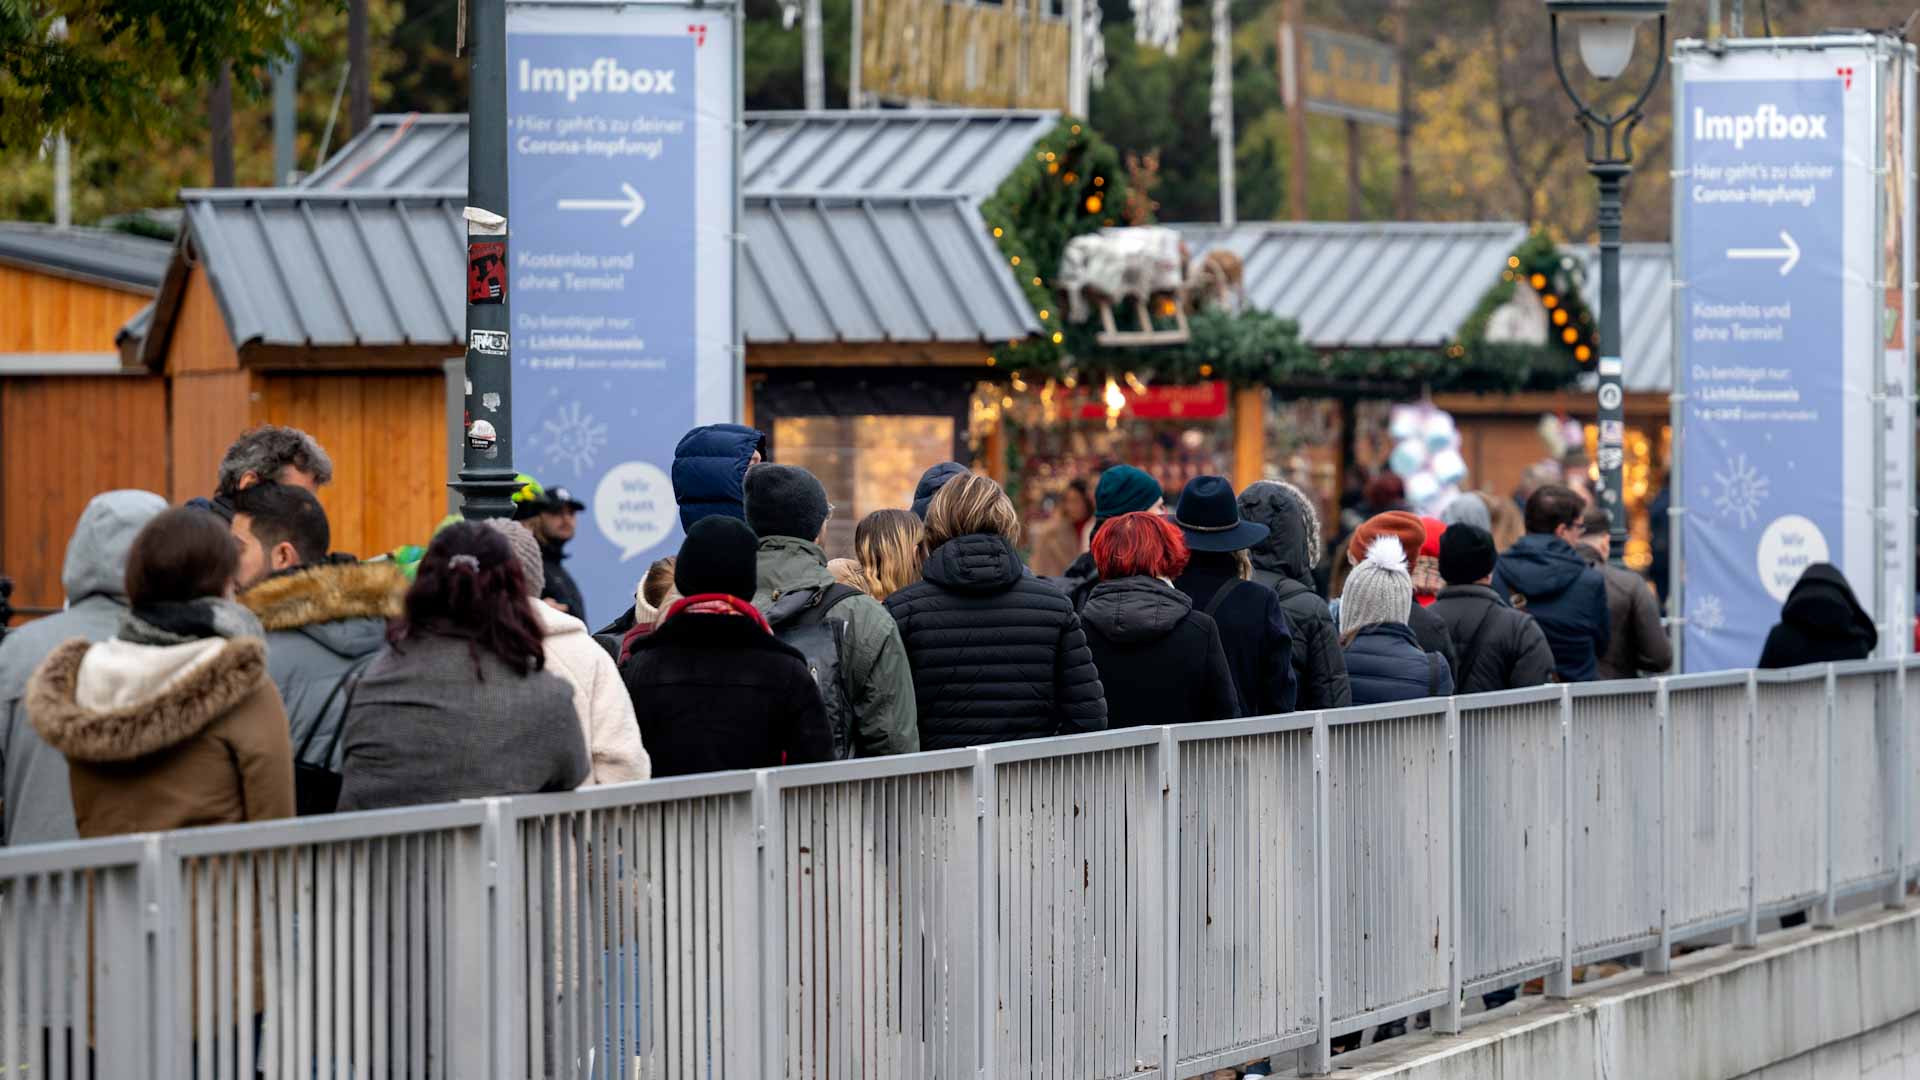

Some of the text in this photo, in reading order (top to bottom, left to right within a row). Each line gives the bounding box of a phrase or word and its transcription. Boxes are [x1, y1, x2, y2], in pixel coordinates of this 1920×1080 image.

[517, 58, 676, 102] Impfbox
[517, 116, 684, 136] Hier geht's zu deiner
[1693, 103, 1828, 150] Impfbox
[517, 137, 663, 159] Corona-Impfung!
[1693, 164, 1722, 181] Hier
[1770, 167, 1788, 180] zu
[1790, 164, 1834, 180] deiner
[1693, 185, 1816, 207] Corona-Impfung!
[517, 251, 635, 270] Kostenlos und
[517, 273, 561, 290] ohne
[1692, 302, 1791, 320] Kostenlos und
[1692, 324, 1728, 341] ohne
